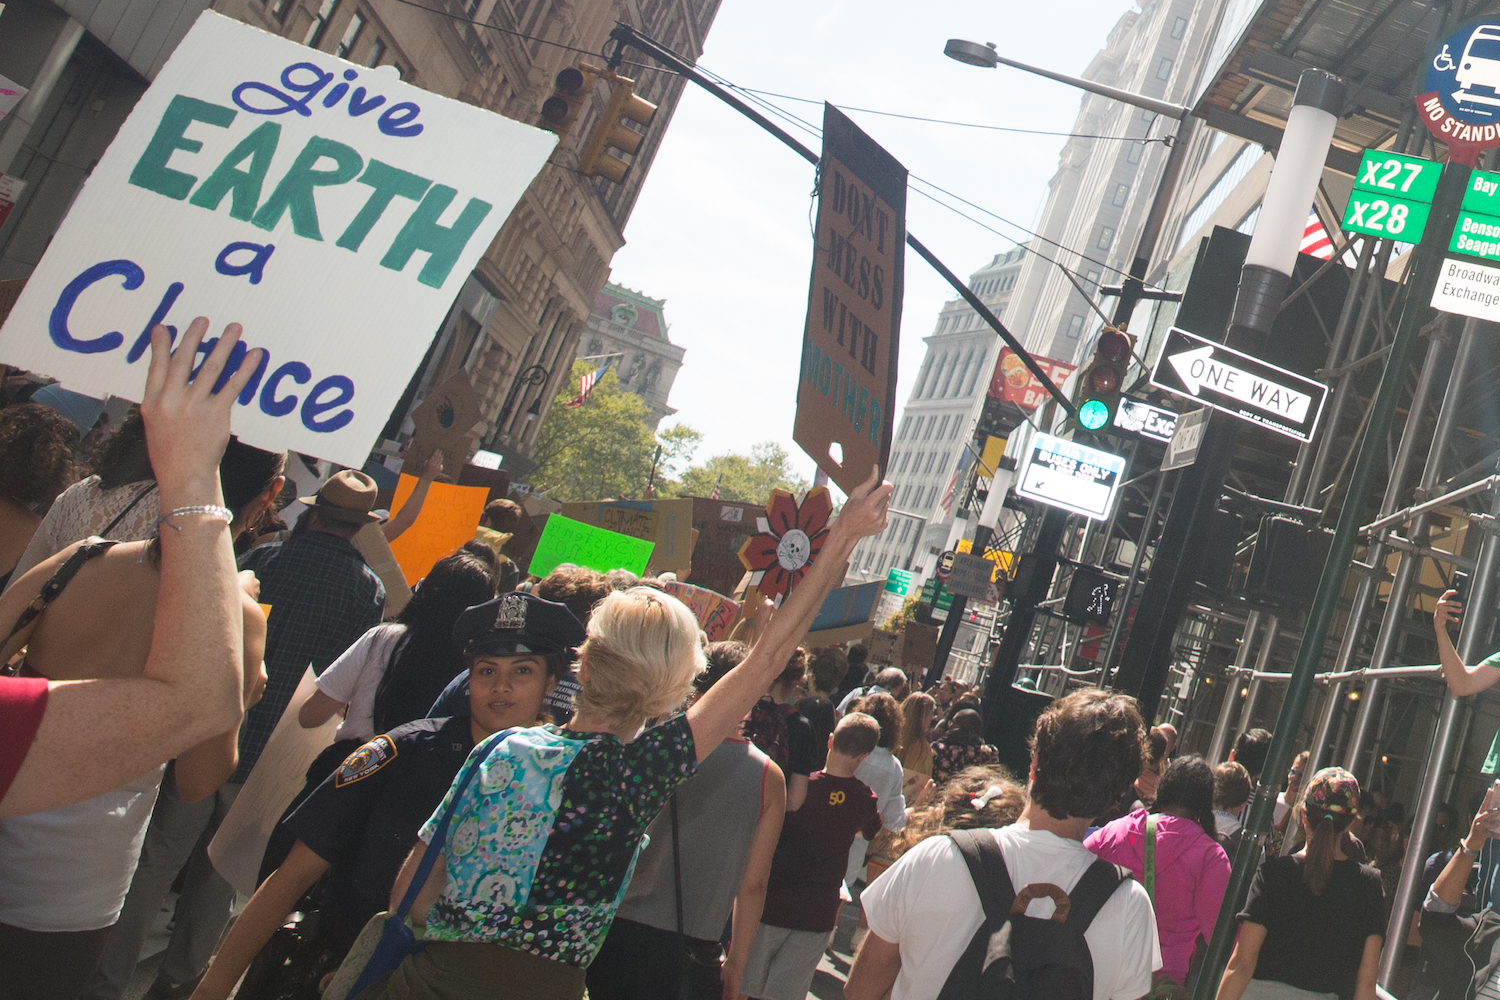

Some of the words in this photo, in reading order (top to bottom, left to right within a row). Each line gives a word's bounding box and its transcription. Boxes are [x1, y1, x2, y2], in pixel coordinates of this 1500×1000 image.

[232, 61, 425, 138] give
[1423, 96, 1443, 121] NO
[127, 94, 494, 290] EARTH
[1473, 176, 1498, 197] Bay
[214, 241, 275, 284] a
[826, 227, 885, 311] MESS
[1442, 282, 1500, 307] Exchange
[822, 286, 879, 377] WITH
[802, 338, 882, 448] MOTHER
[1190, 359, 1239, 392] ONE
[1251, 380, 1299, 413] WAY
[1262, 418, 1306, 438] TRANSPORTATION
[1038, 449, 1078, 471] BUSES
[1080, 463, 1110, 480] ONLY
[604, 508, 652, 529] CLIMATE
[359, 763, 380, 776] YORK
[828, 790, 846, 806] 50
